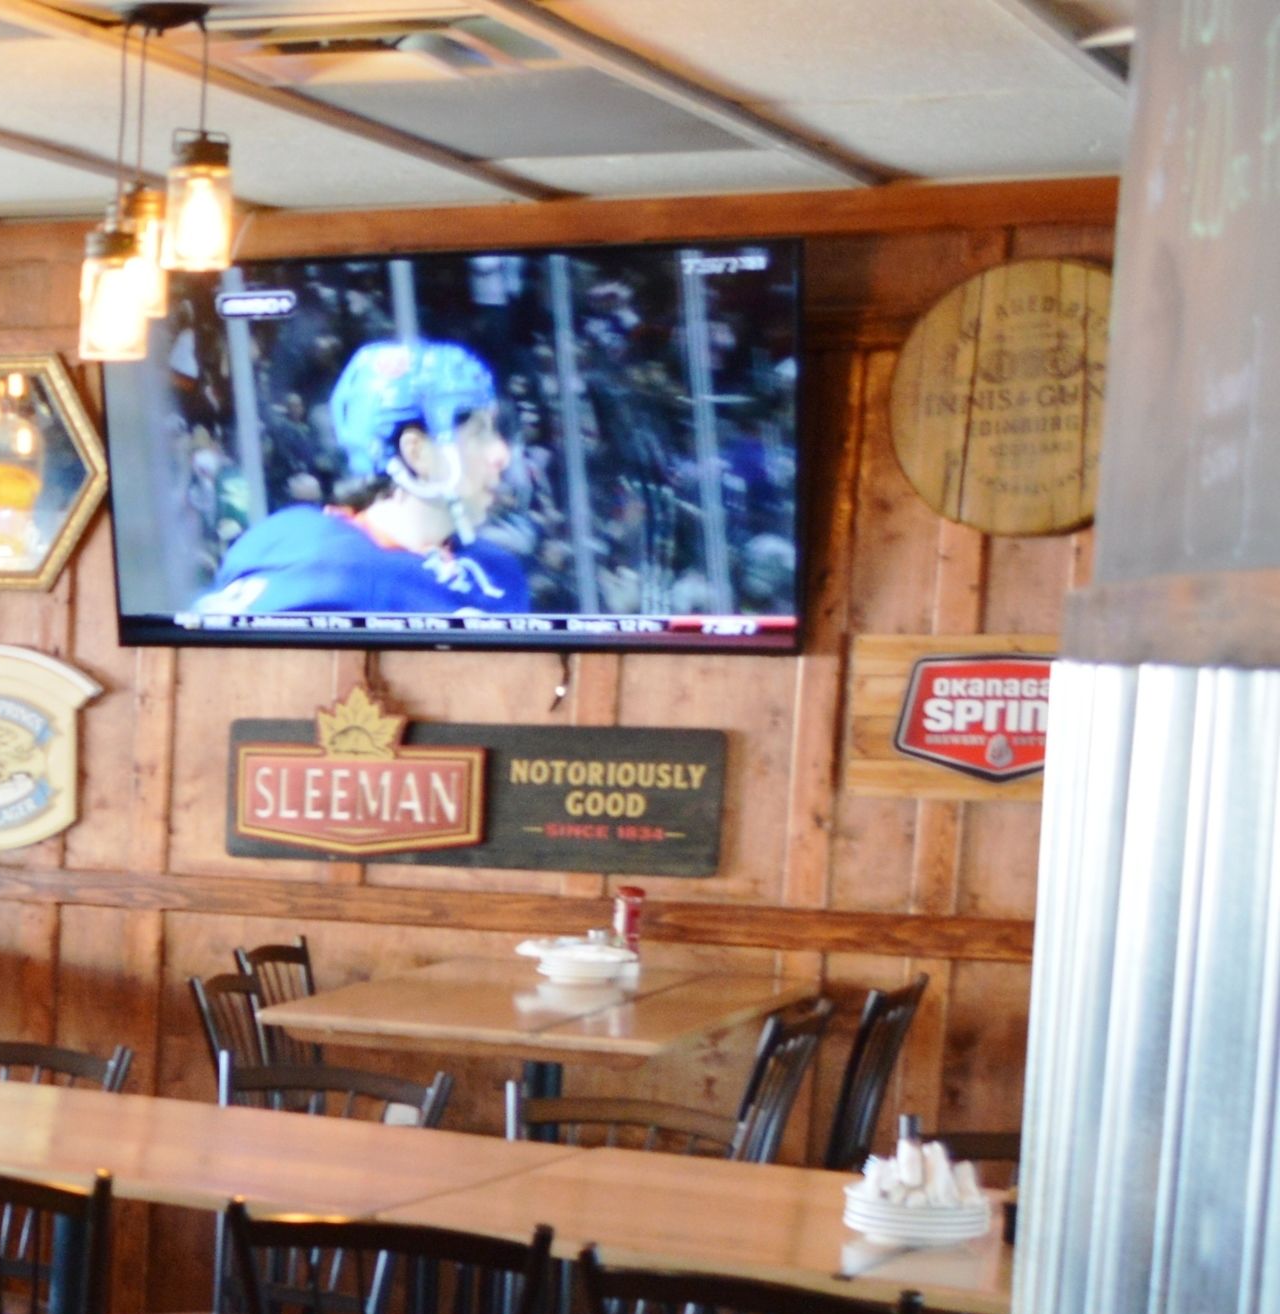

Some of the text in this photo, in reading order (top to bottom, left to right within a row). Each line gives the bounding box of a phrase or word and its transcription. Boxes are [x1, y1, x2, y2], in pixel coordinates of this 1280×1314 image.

[510, 758, 707, 790] NOTORIOUSLY
[254, 766, 459, 824] SLEEMAN
[565, 791, 647, 818] GOOD
